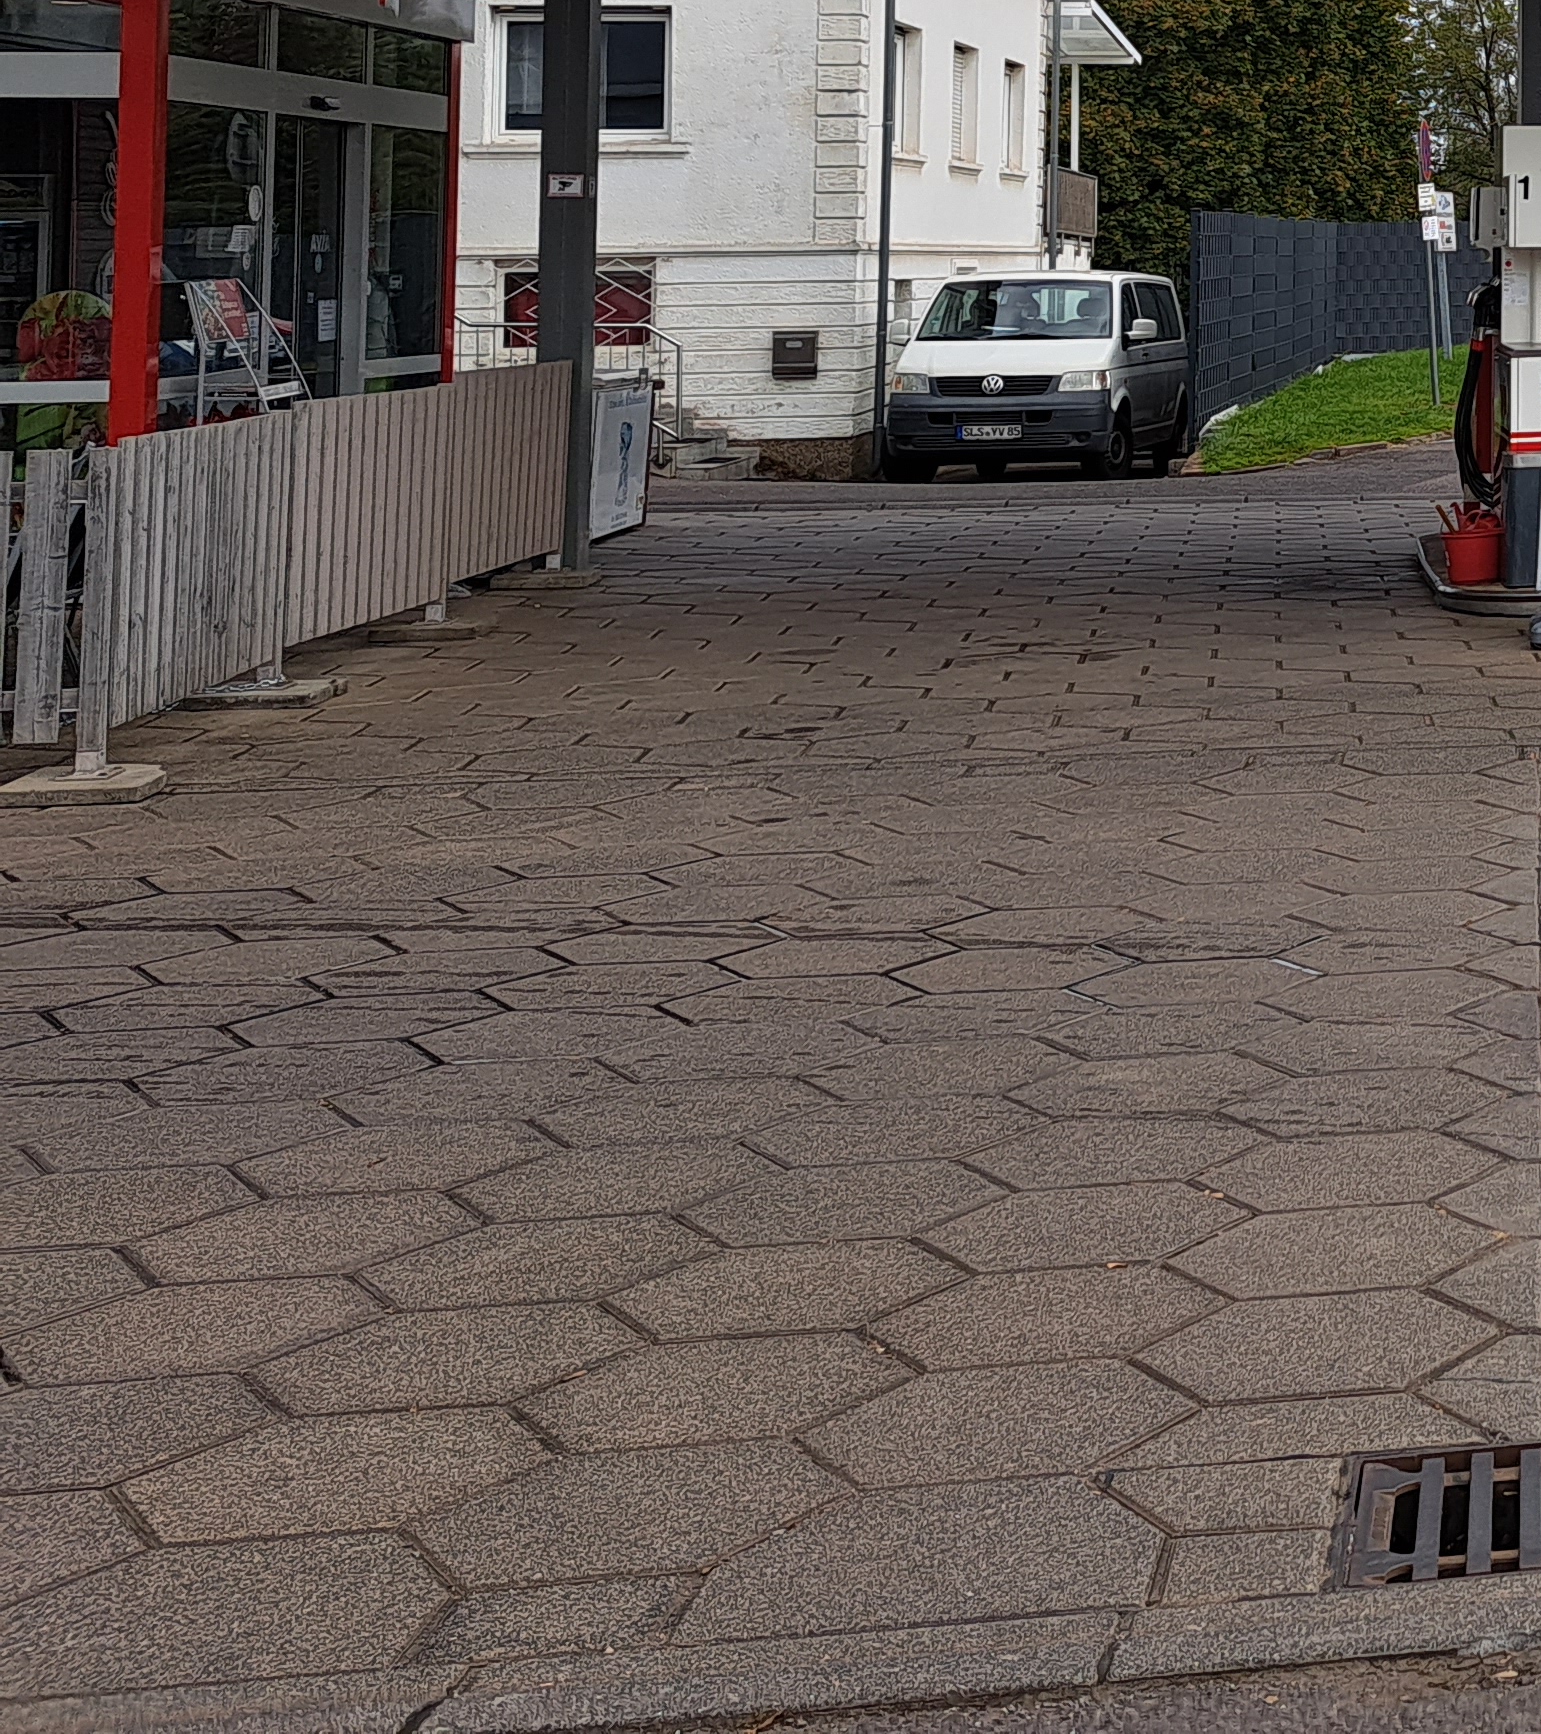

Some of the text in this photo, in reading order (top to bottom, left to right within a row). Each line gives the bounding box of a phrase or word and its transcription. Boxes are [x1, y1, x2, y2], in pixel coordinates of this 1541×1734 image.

[1517, 175, 1530, 200] 1
[963, 426, 1021, 437] SLS YV 85
